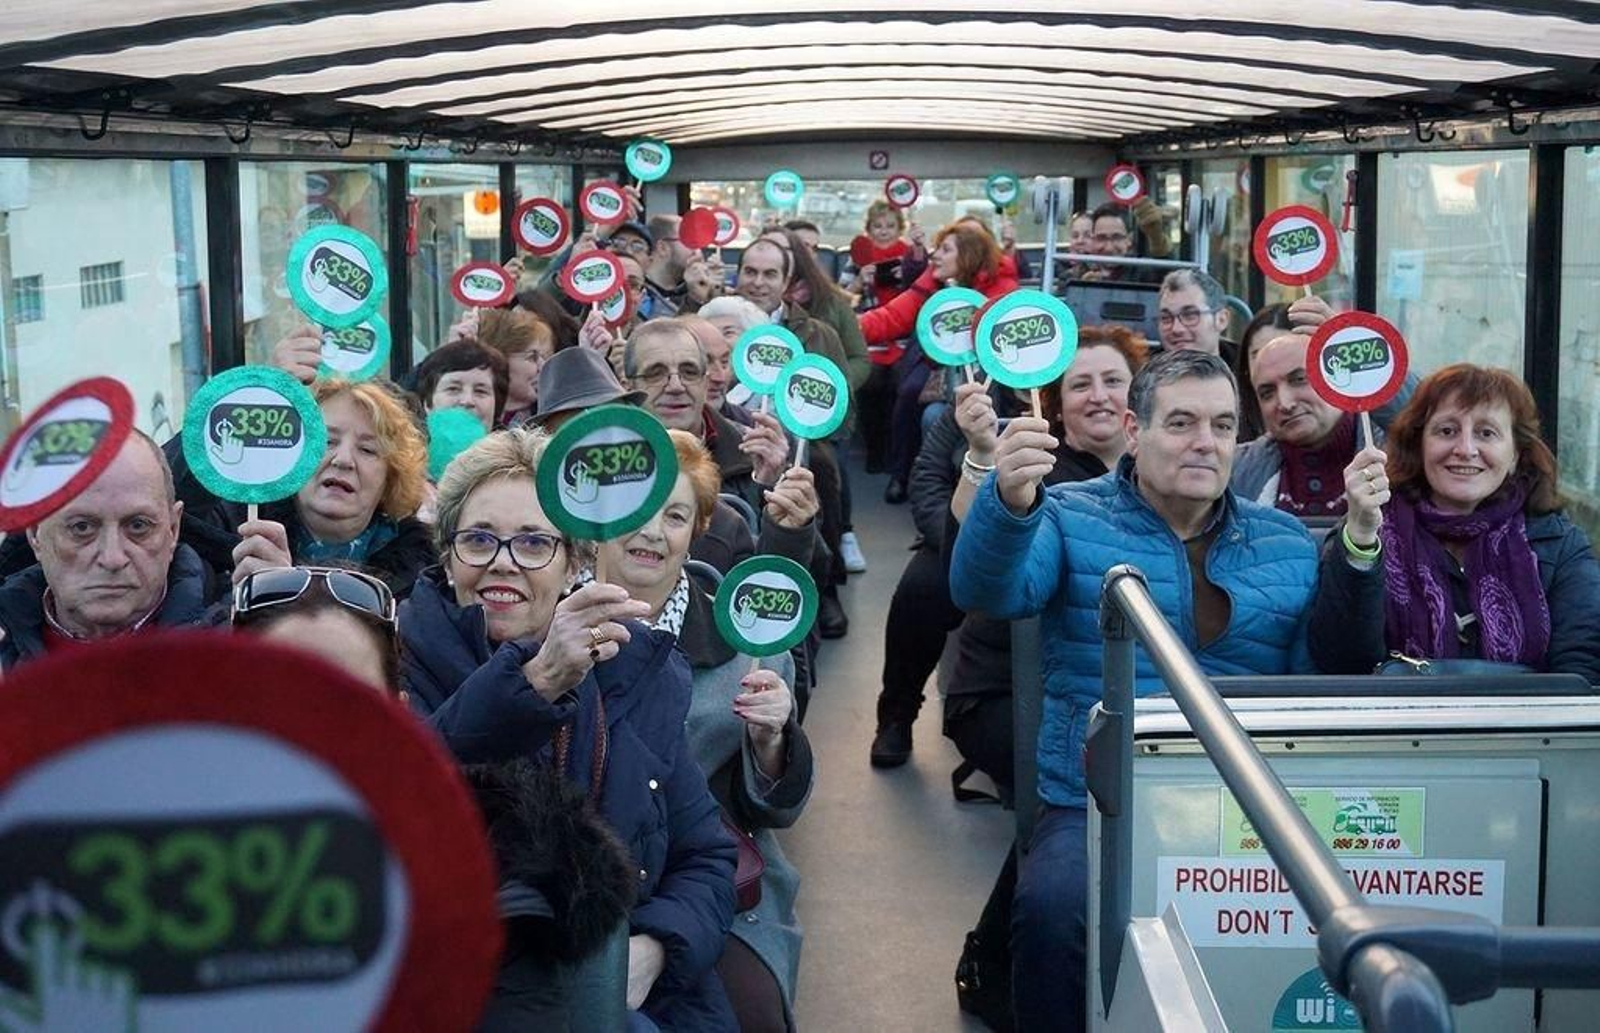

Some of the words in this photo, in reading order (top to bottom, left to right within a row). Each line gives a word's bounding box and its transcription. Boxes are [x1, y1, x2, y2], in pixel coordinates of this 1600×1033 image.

[1277, 229, 1316, 251] 33%
[325, 255, 367, 293] 33%
[1004, 316, 1050, 343] 33%
[758, 345, 790, 363] 33%
[1337, 340, 1384, 367] 33%
[800, 378, 832, 403] 33%
[231, 406, 294, 437] 33%
[586, 443, 649, 476] 33%
[752, 587, 794, 613] 33%
[1333, 838, 1353, 850] 986
[1354, 838, 1369, 850] 29
[1371, 838, 1385, 850] 16
[1386, 838, 1401, 850] 00
[68, 822, 360, 954] 33%
[1176, 867, 1292, 893] PROHIBID
[1345, 869, 1484, 896] VANTARSE
